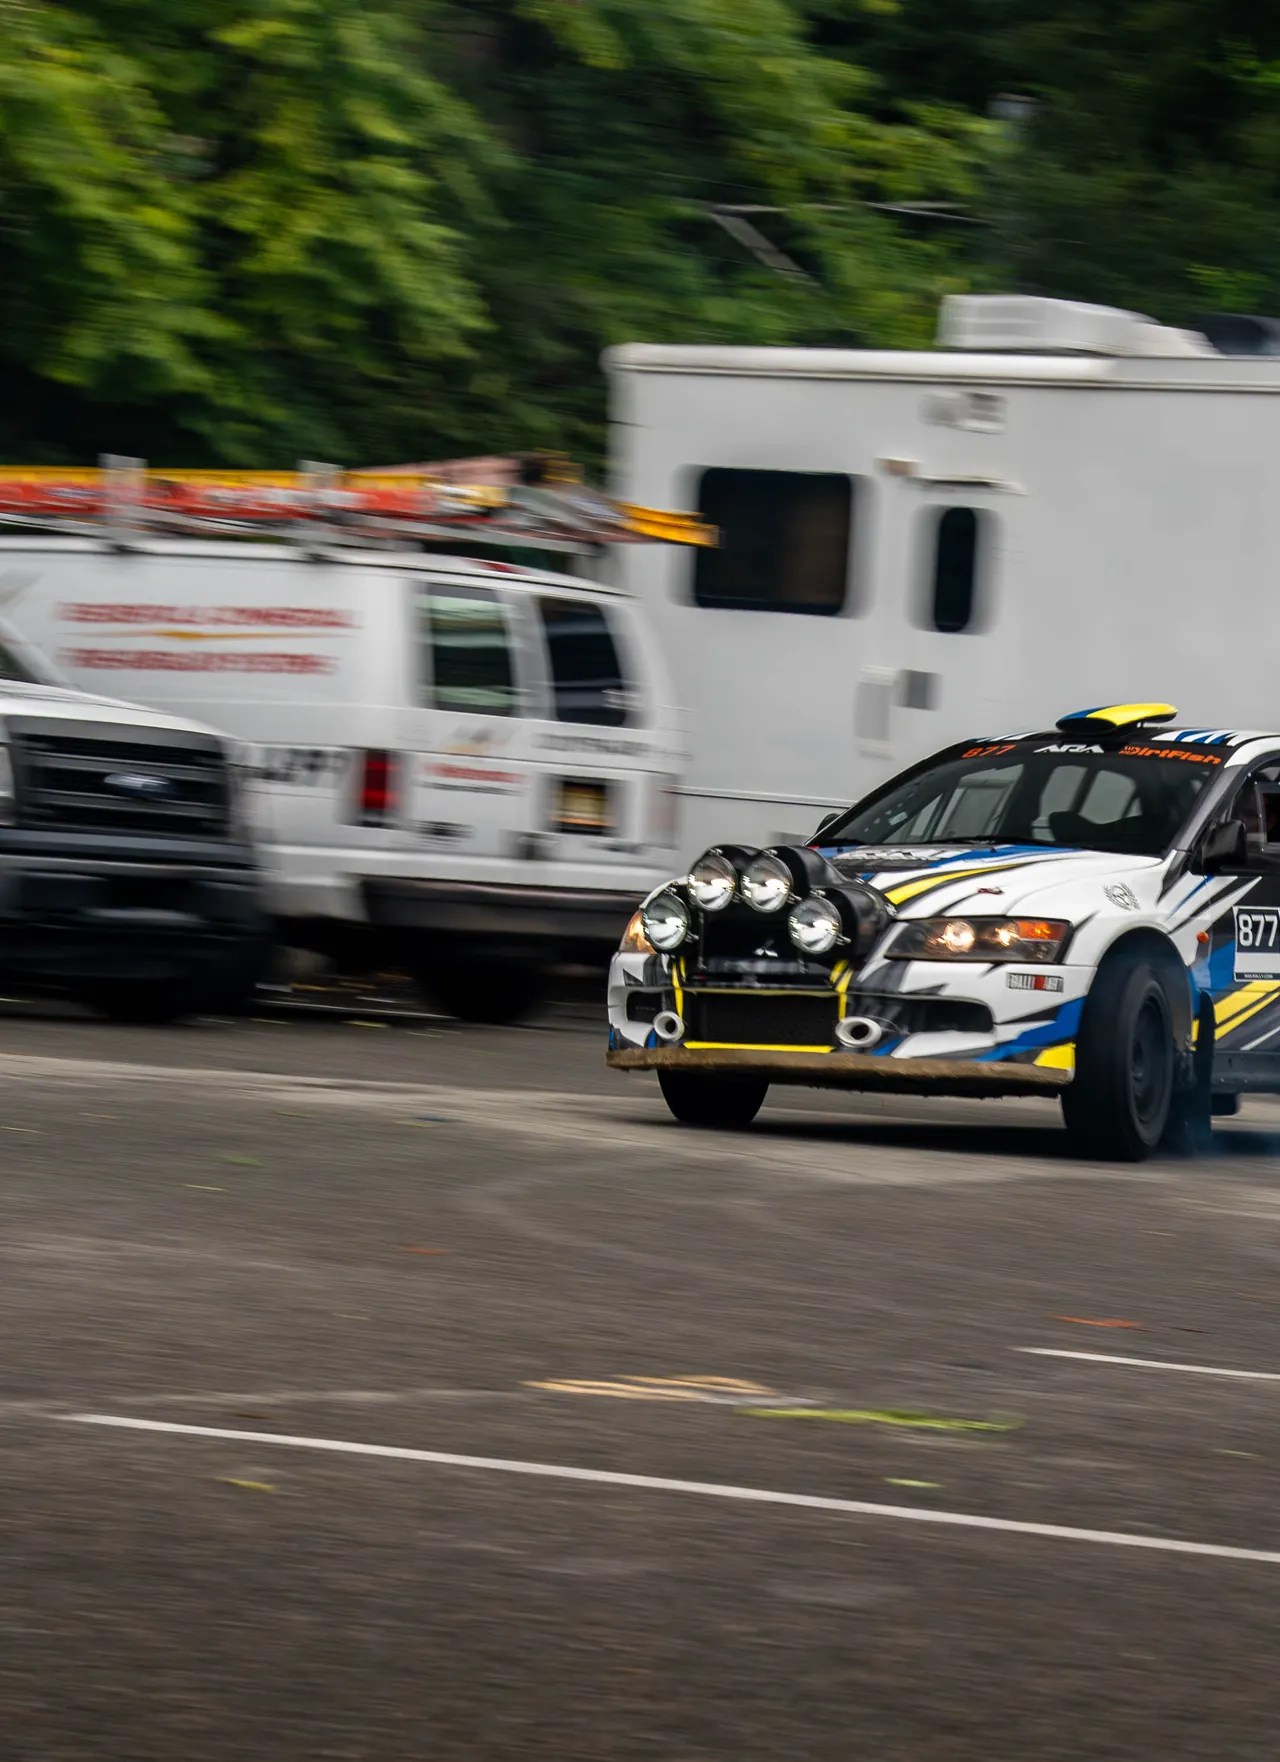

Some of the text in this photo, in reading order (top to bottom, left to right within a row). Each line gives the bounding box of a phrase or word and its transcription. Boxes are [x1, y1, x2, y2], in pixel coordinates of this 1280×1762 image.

[961, 744, 1017, 759] 877
[1033, 744, 1105, 754] ARA
[1118, 745, 1221, 765] DirtFish
[1238, 913, 1278, 947] 877
